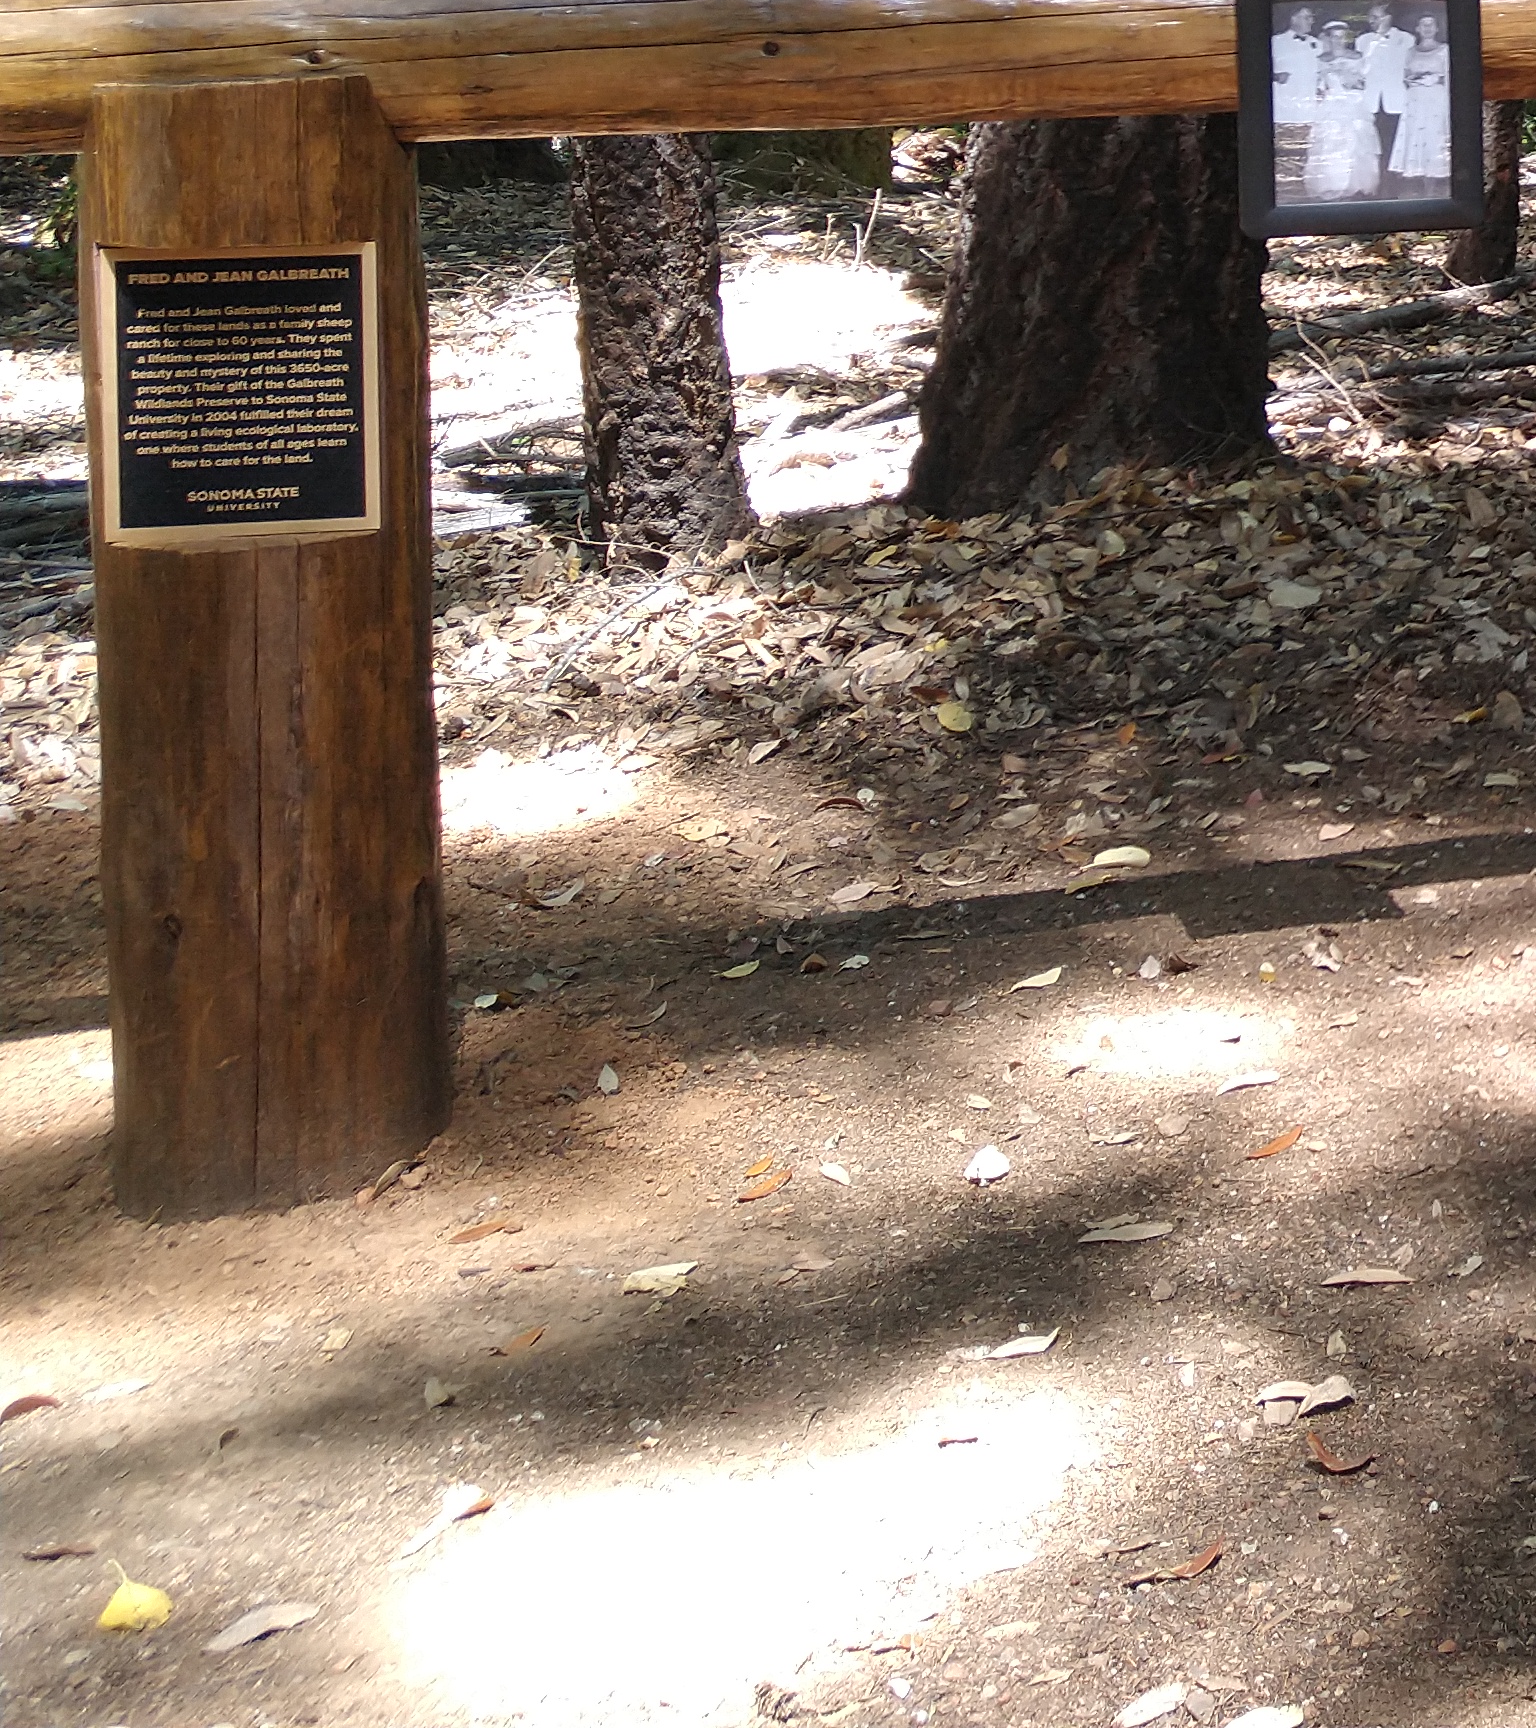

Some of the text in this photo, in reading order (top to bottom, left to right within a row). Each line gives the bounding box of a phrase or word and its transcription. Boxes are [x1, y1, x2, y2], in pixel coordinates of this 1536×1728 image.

[127, 267, 349, 284] FRED AND JEAN GALBREATH
[147, 352, 193, 363] lifetime
[194, 350, 250, 364] exploring
[252, 349, 275, 359] and
[276, 348, 321, 361] sharing
[323, 347, 343, 357] the
[130, 361, 349, 381] beauty and mystery of this 3650-acre
[194, 381, 225, 391] Their
[226, 380, 248, 393] gift
[249, 379, 262, 389] of
[264, 379, 284, 389] the
[286, 377, 344, 388] Galbreath
[134, 391, 347, 408] Wildlands Preserve to Sonoma State
[127, 406, 353, 427] University in 2004 fulfilled their dream
[123, 429, 137, 439] of
[138, 427, 188, 442] creating
[200, 426, 233, 439] living
[234, 423, 294, 438] ecological
[136, 436, 347, 454] one where students of all ages learn
[171, 457, 198, 467] how
[199, 457, 213, 466] to
[214, 458, 241, 466] care
[242, 455, 260, 465] for
[261, 454, 282, 464] the
[187, 486, 299, 501] SONOMA STATE
[206, 501, 280, 512] UNIVERSITY
